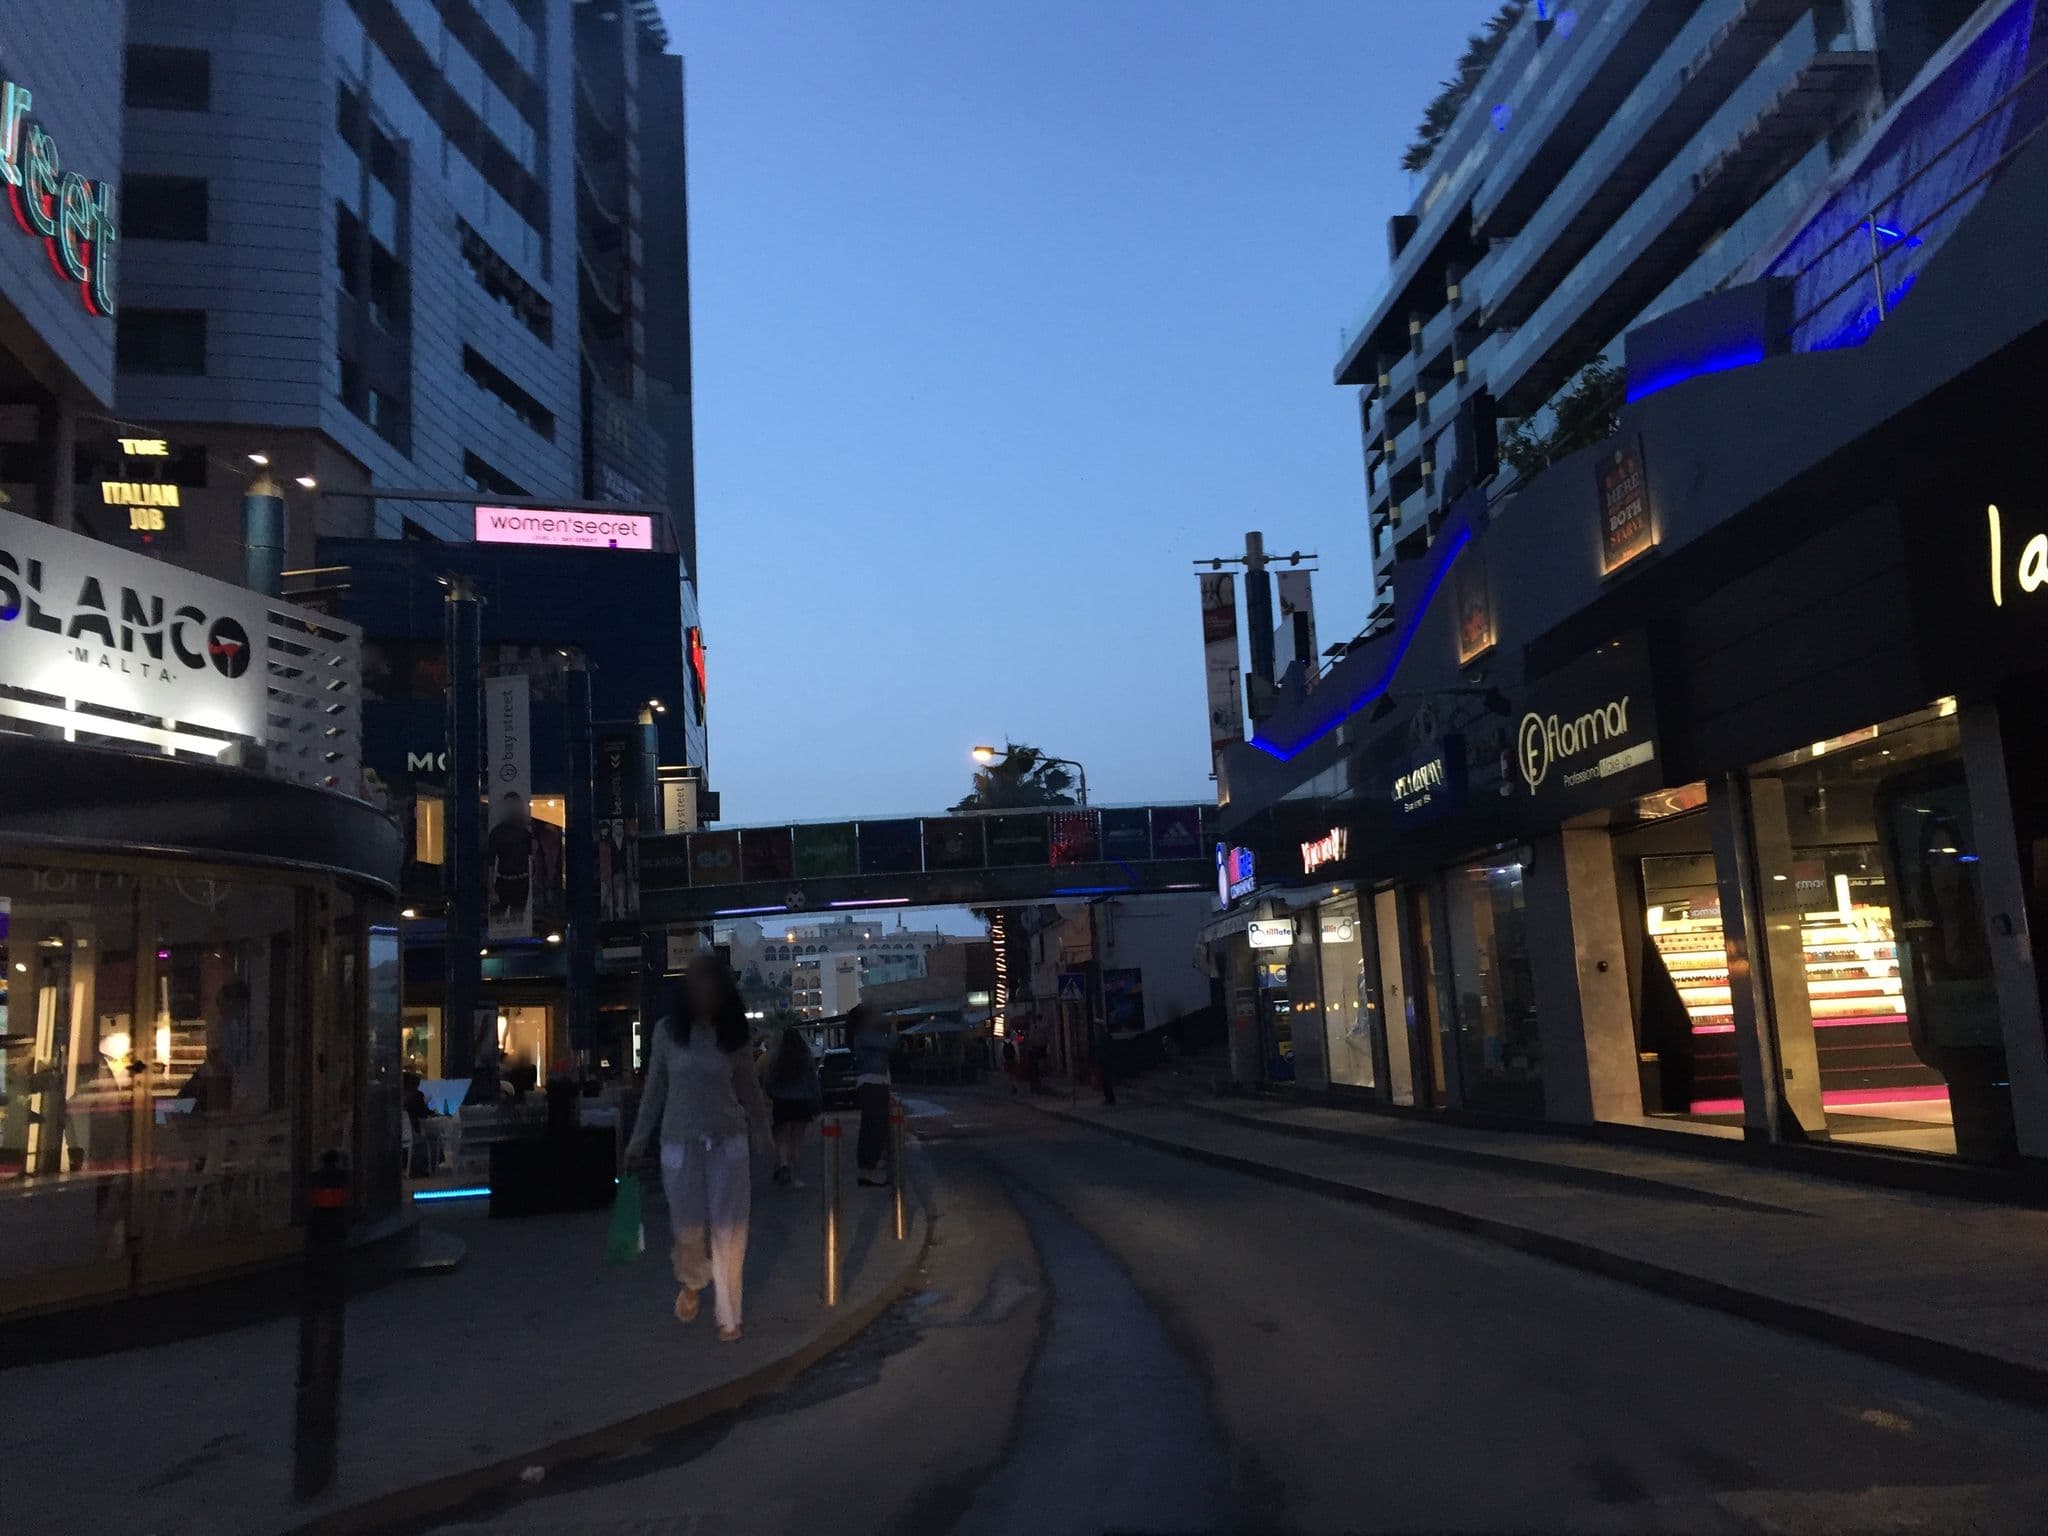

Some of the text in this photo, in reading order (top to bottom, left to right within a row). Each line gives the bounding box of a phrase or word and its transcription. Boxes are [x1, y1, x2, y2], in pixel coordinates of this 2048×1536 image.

[101, 481, 180, 507] ITALIAN
[129, 507, 166, 530] JOB
[490, 515, 639, 537] women'secret
[1547, 695, 1630, 762] flormar
